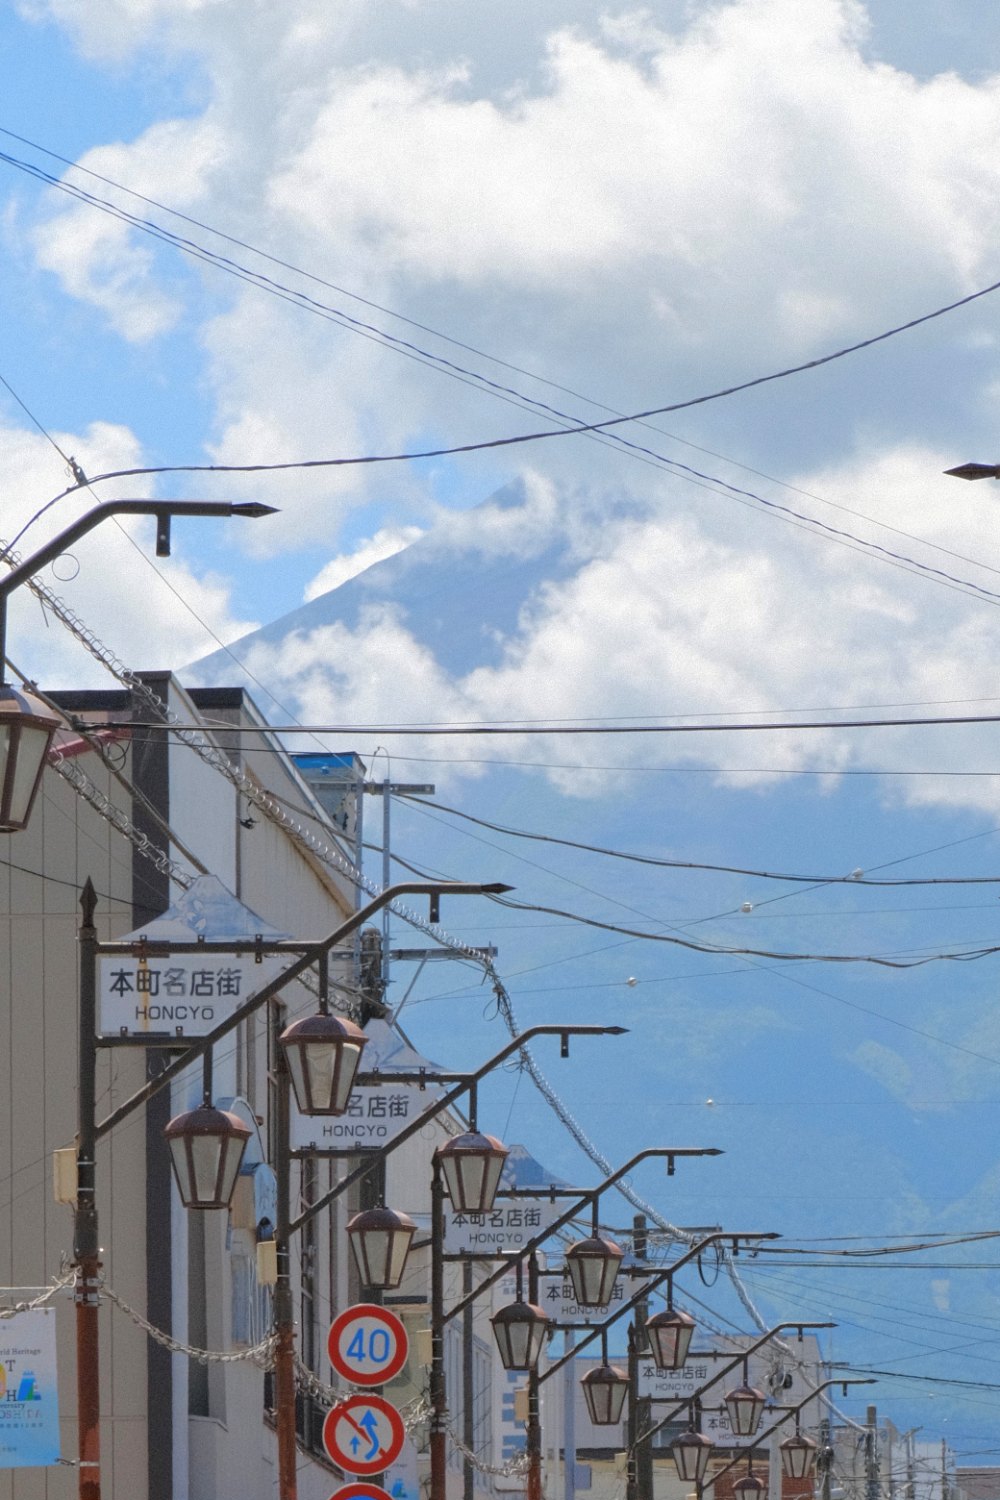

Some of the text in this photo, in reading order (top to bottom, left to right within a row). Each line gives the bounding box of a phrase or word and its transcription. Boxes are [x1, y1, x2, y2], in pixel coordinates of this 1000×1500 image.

[109, 967, 242, 997] 本町名店街
[346, 1328, 390, 1364] 40
